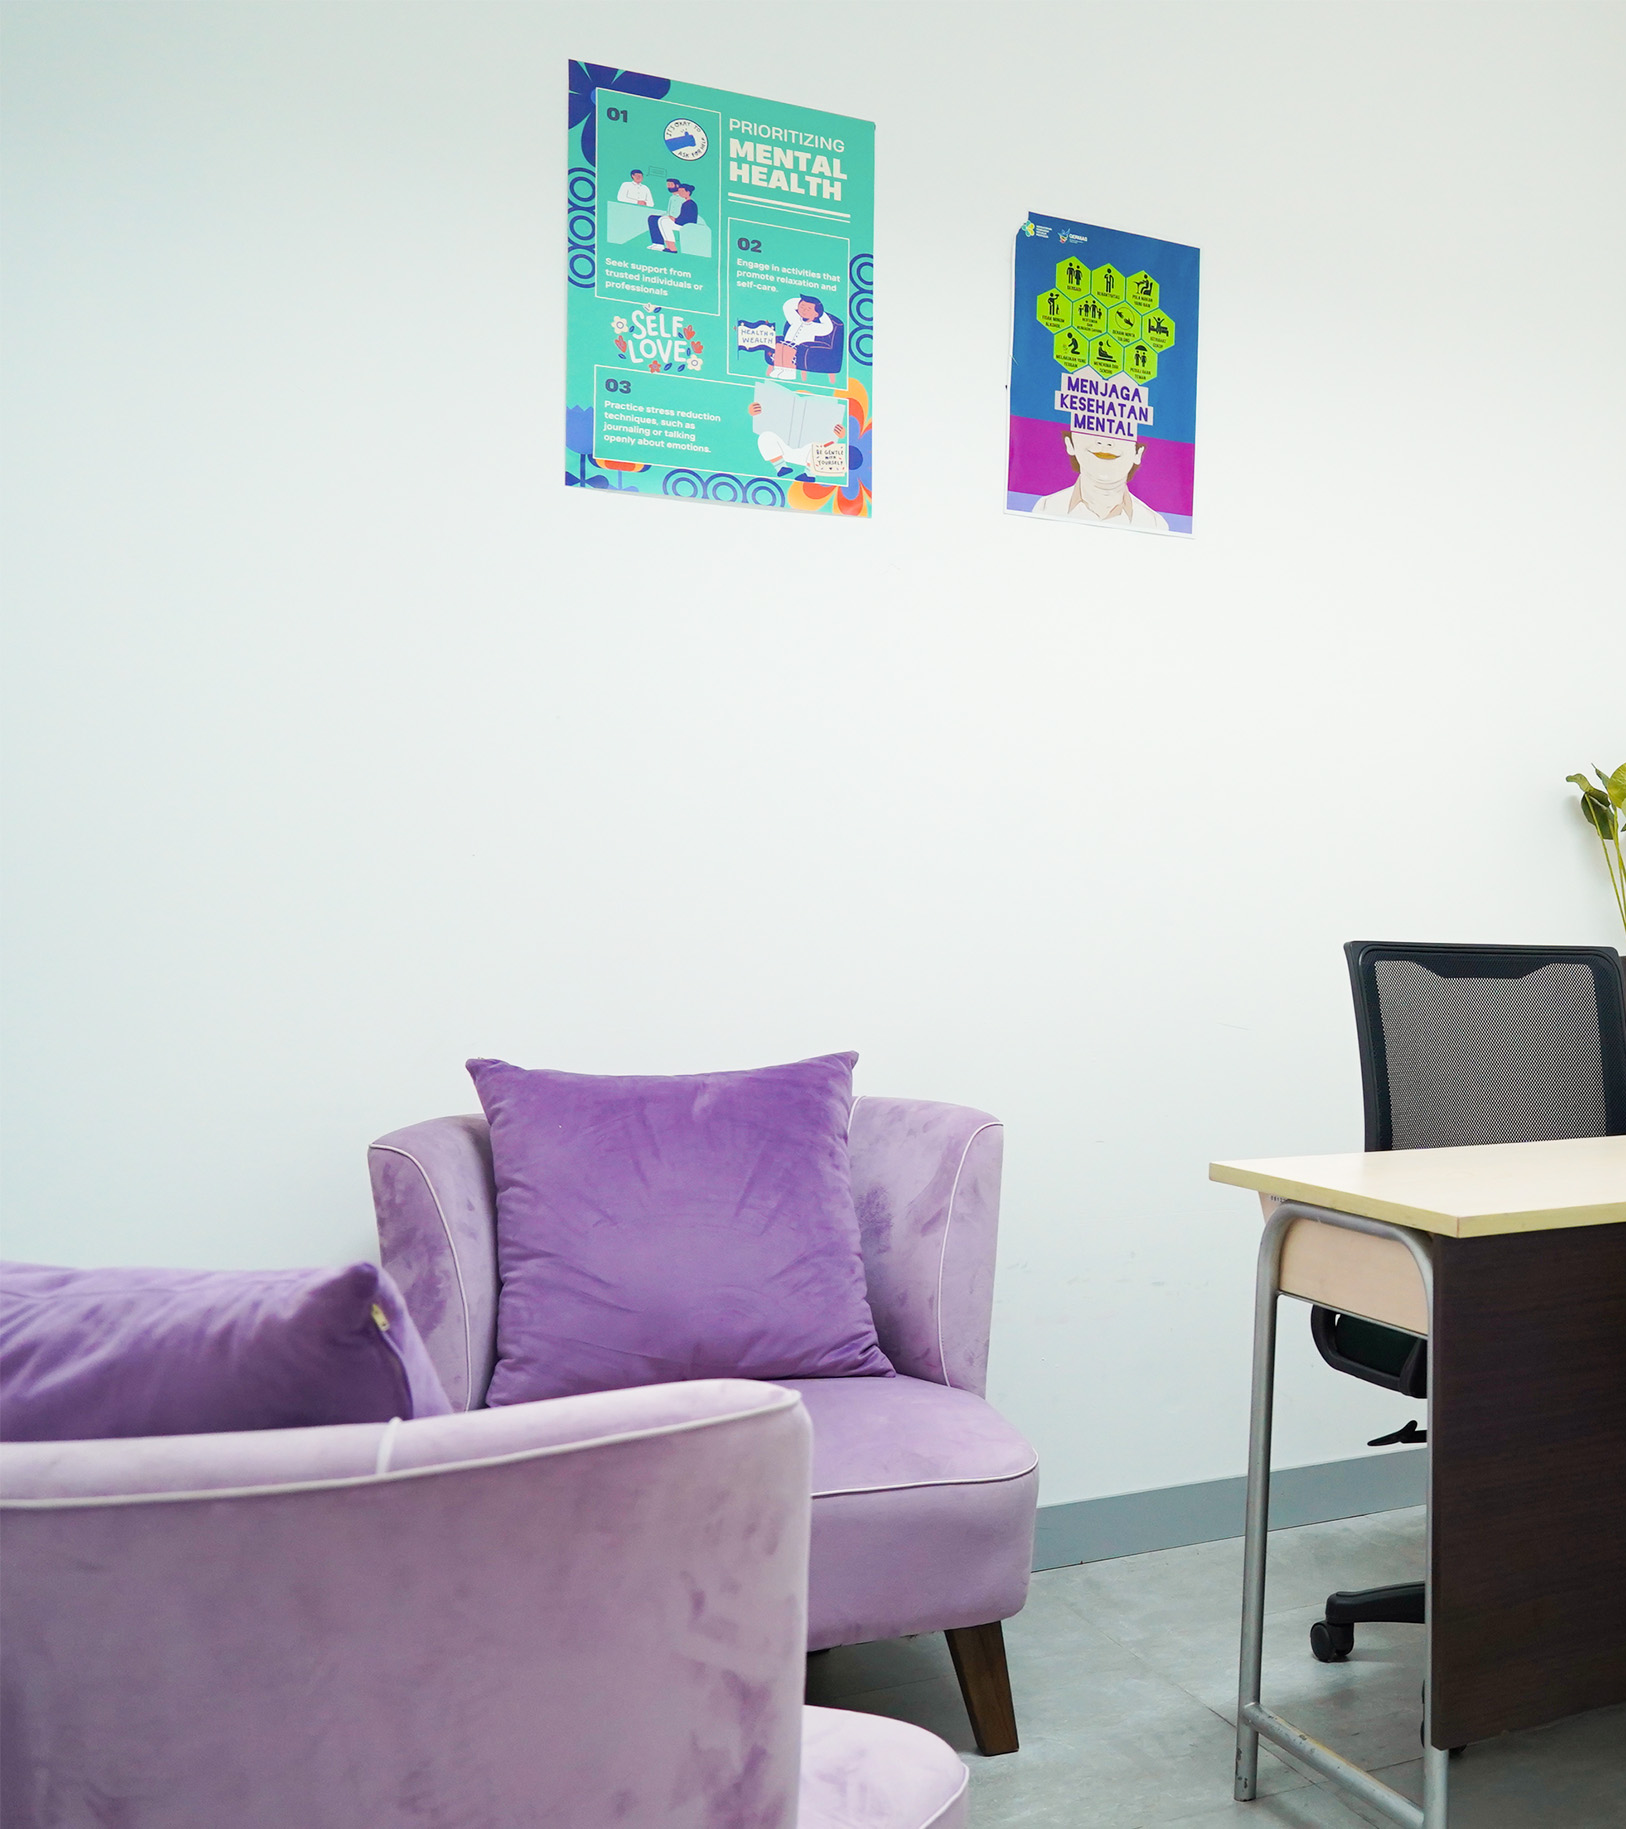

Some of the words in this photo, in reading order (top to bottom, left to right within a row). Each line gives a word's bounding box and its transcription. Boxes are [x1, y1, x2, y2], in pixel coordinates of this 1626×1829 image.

[606, 107, 628, 123] 01
[729, 118, 845, 153] PRIORITIZING
[729, 138, 848, 180] MENTAL
[729, 162, 842, 202] HEALTH
[737, 237, 762, 253] 02
[605, 258, 629, 269] Seek
[631, 262, 667, 275] support
[669, 267, 692, 279] from
[736, 258, 770, 272] Engage
[771, 264, 780, 272] in
[781, 266, 821, 279] activities
[823, 272, 841, 283] that
[605, 269, 640, 281] trusted
[642, 274, 691, 289] individuals
[693, 283, 703, 291] or
[605, 280, 669, 296] professionals
[736, 270, 775, 282] promote
[776, 275, 820, 288] relaxation
[821, 282, 837, 291] and
[631, 310, 684, 340] SELF
[628, 338, 688, 363] LOVE
[605, 378, 632, 394] 03
[1067, 376, 1142, 403] MENJAGA
[604, 400, 644, 412] Practice
[646, 405, 675, 416] stress
[676, 409, 721, 422] reduction
[1060, 393, 1149, 422] KESEHATAN
[603, 421, 651, 437] journaling
[652, 429, 662, 437] or
[664, 429, 696, 442] talking
[661, 418, 683, 429] such
[685, 421, 695, 429] as
[1074, 413, 1134, 437] MENTAL
[603, 434, 636, 446] openly
[637, 437, 665, 448] about
[666, 441, 711, 453] emotions.
